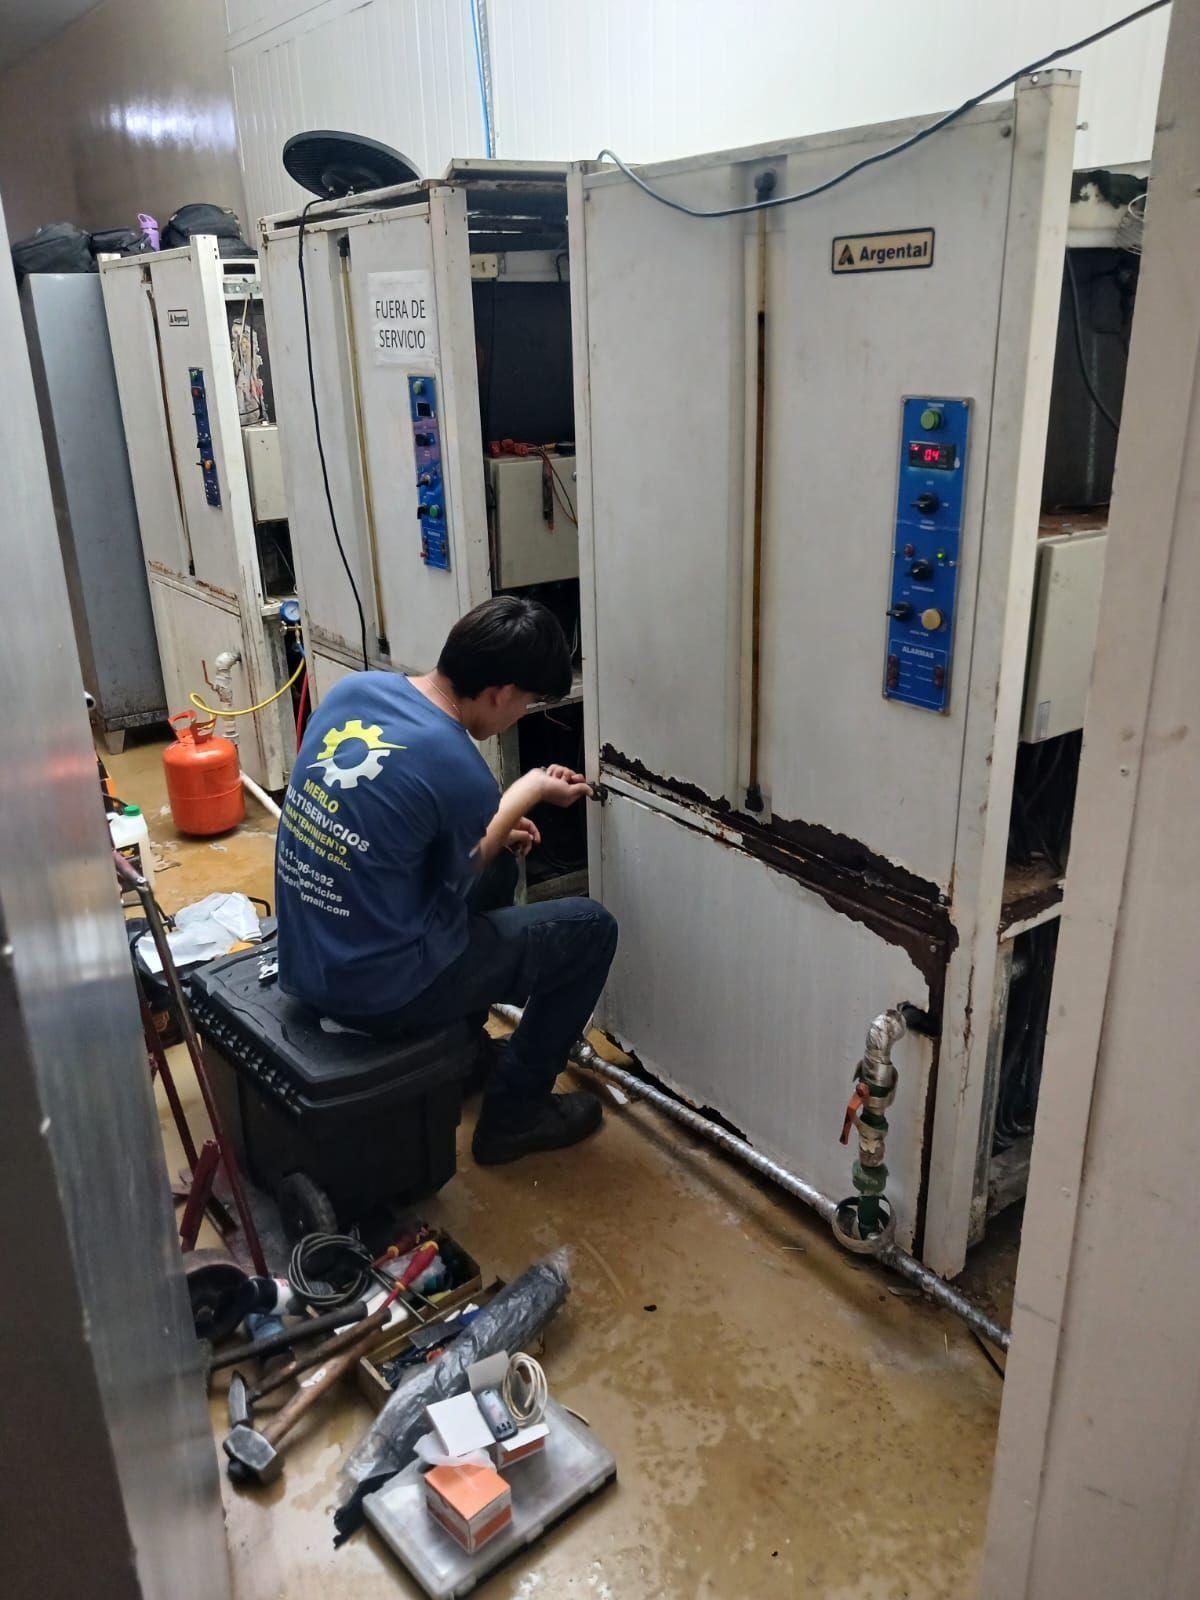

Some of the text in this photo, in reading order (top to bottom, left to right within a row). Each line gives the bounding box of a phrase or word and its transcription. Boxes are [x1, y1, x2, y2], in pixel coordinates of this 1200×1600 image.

[859, 241, 928, 264] Argental
[375, 299, 426, 319] FUERA DE
[379, 329, 426, 349] SERVICIO
[303, 778, 339, 814] MERLO
